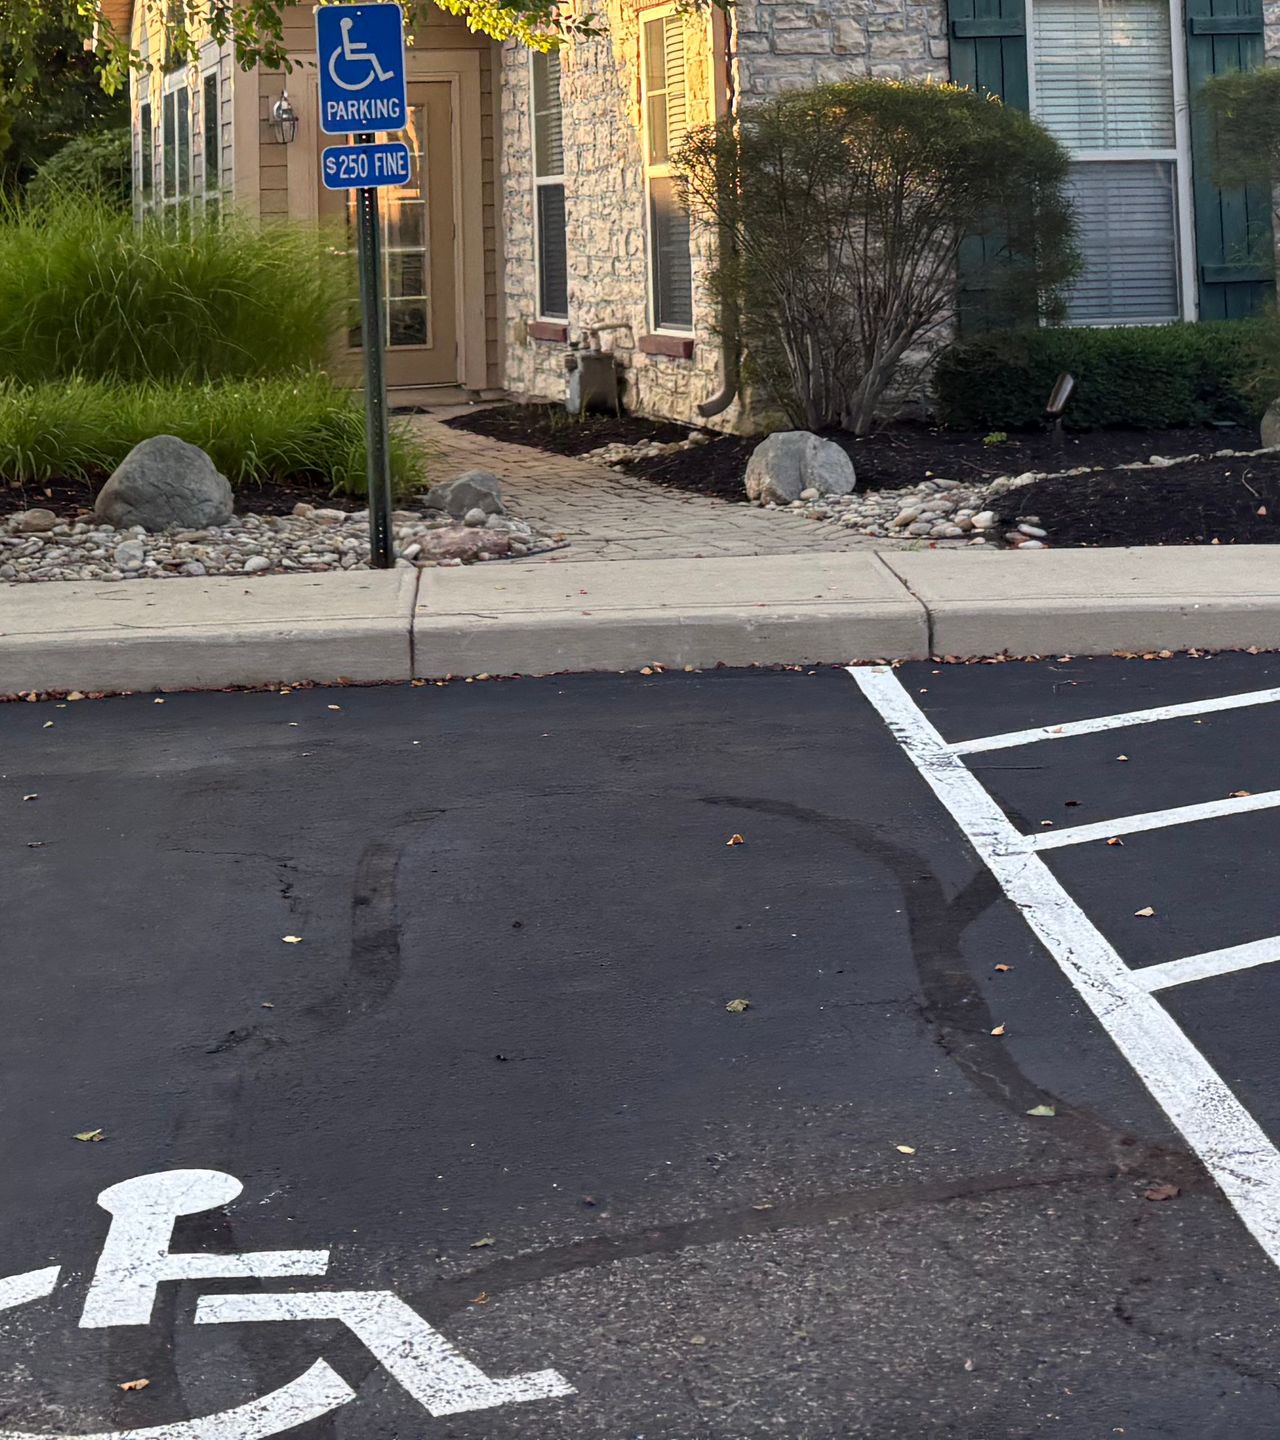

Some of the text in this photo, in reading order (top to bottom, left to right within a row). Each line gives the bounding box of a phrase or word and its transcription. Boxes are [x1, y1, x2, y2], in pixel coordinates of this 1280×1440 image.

[327, 98, 400, 121] PARKING
[326, 152, 407, 179] $250 FINE
